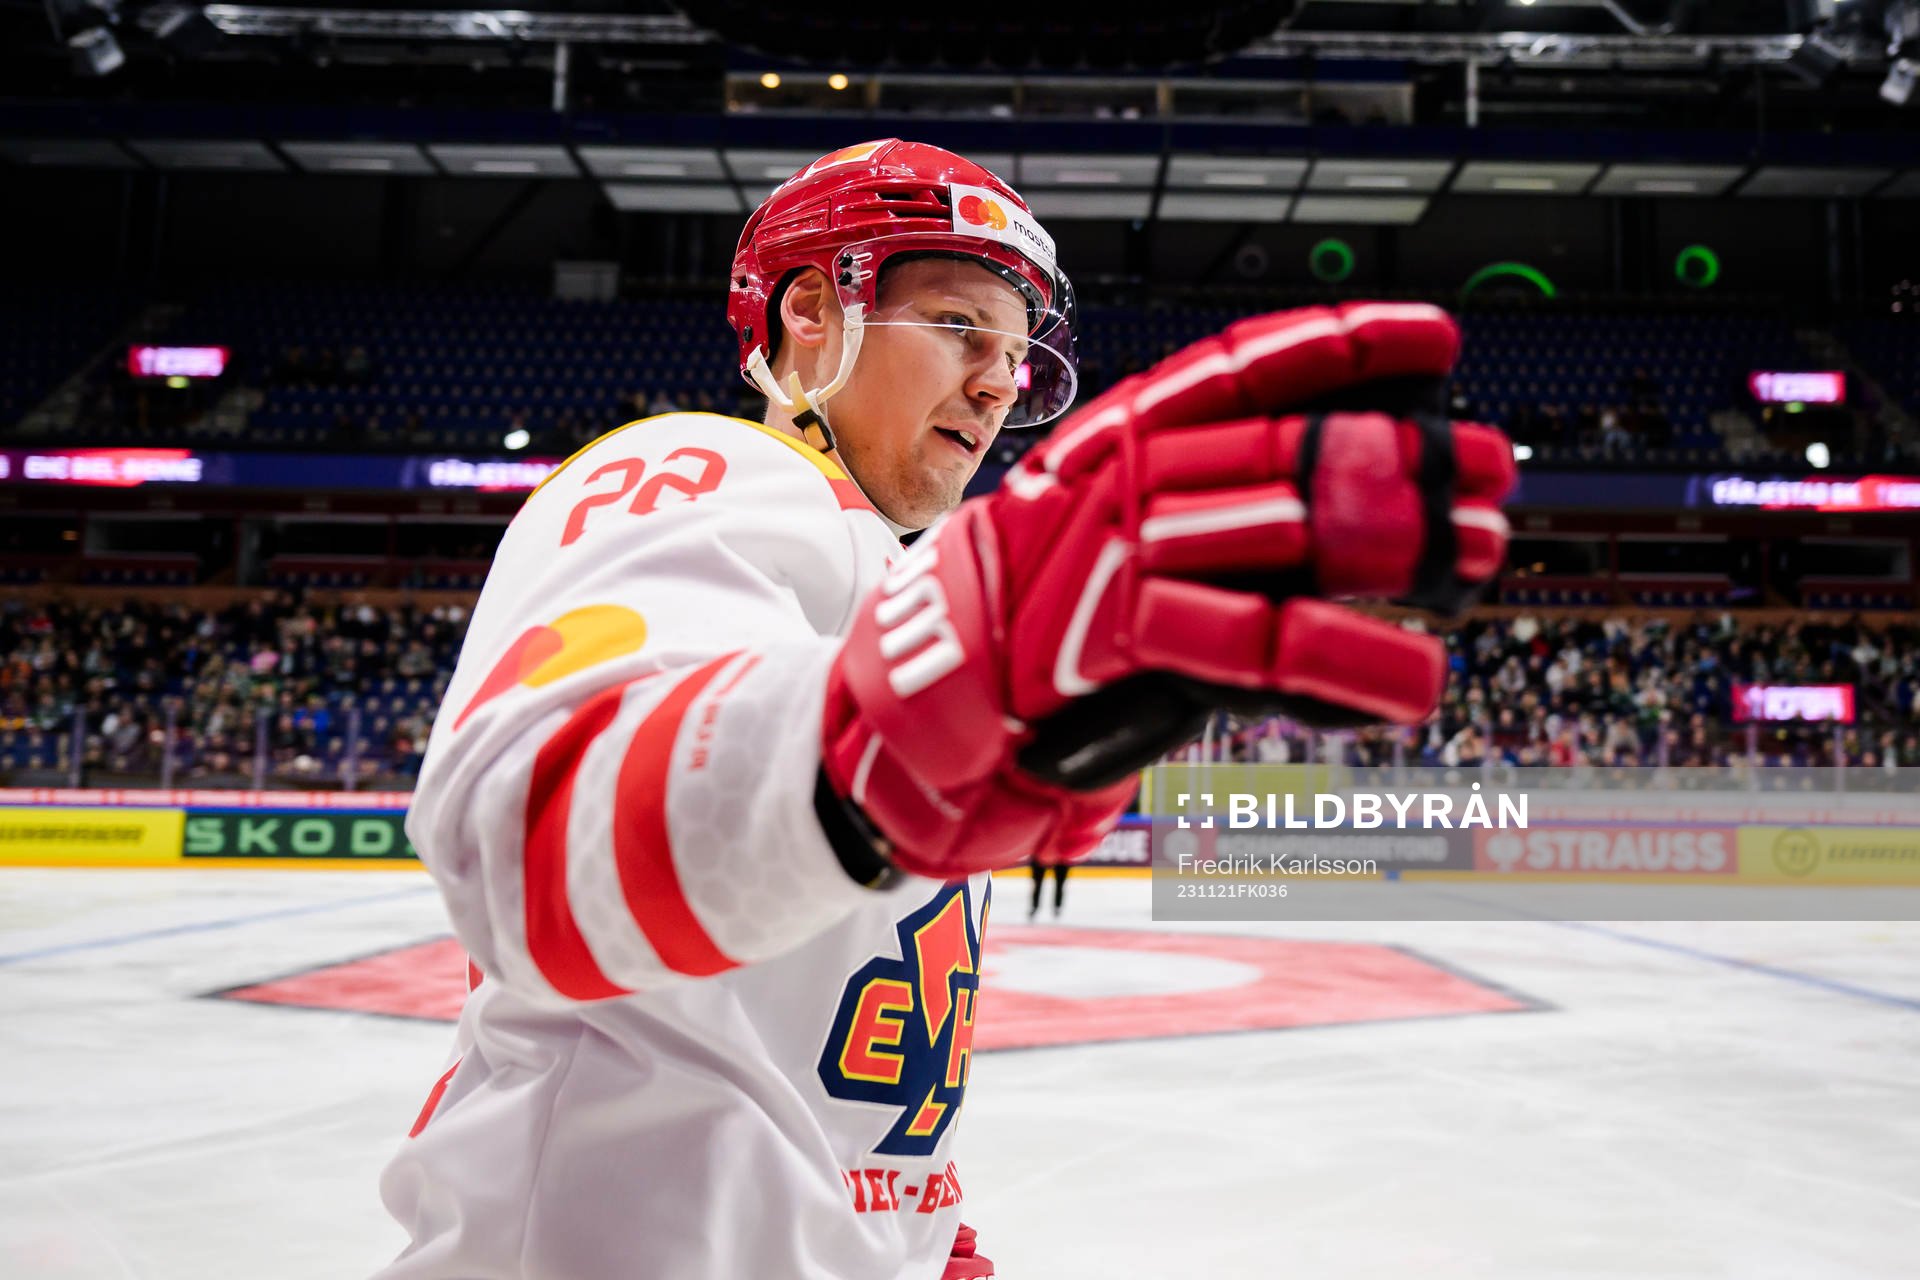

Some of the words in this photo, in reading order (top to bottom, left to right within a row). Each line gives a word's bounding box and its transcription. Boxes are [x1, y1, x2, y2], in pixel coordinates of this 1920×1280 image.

[560, 447, 727, 547] 22
[186, 817, 419, 856] SKOD
[1525, 830, 1727, 872] STRAUSS
